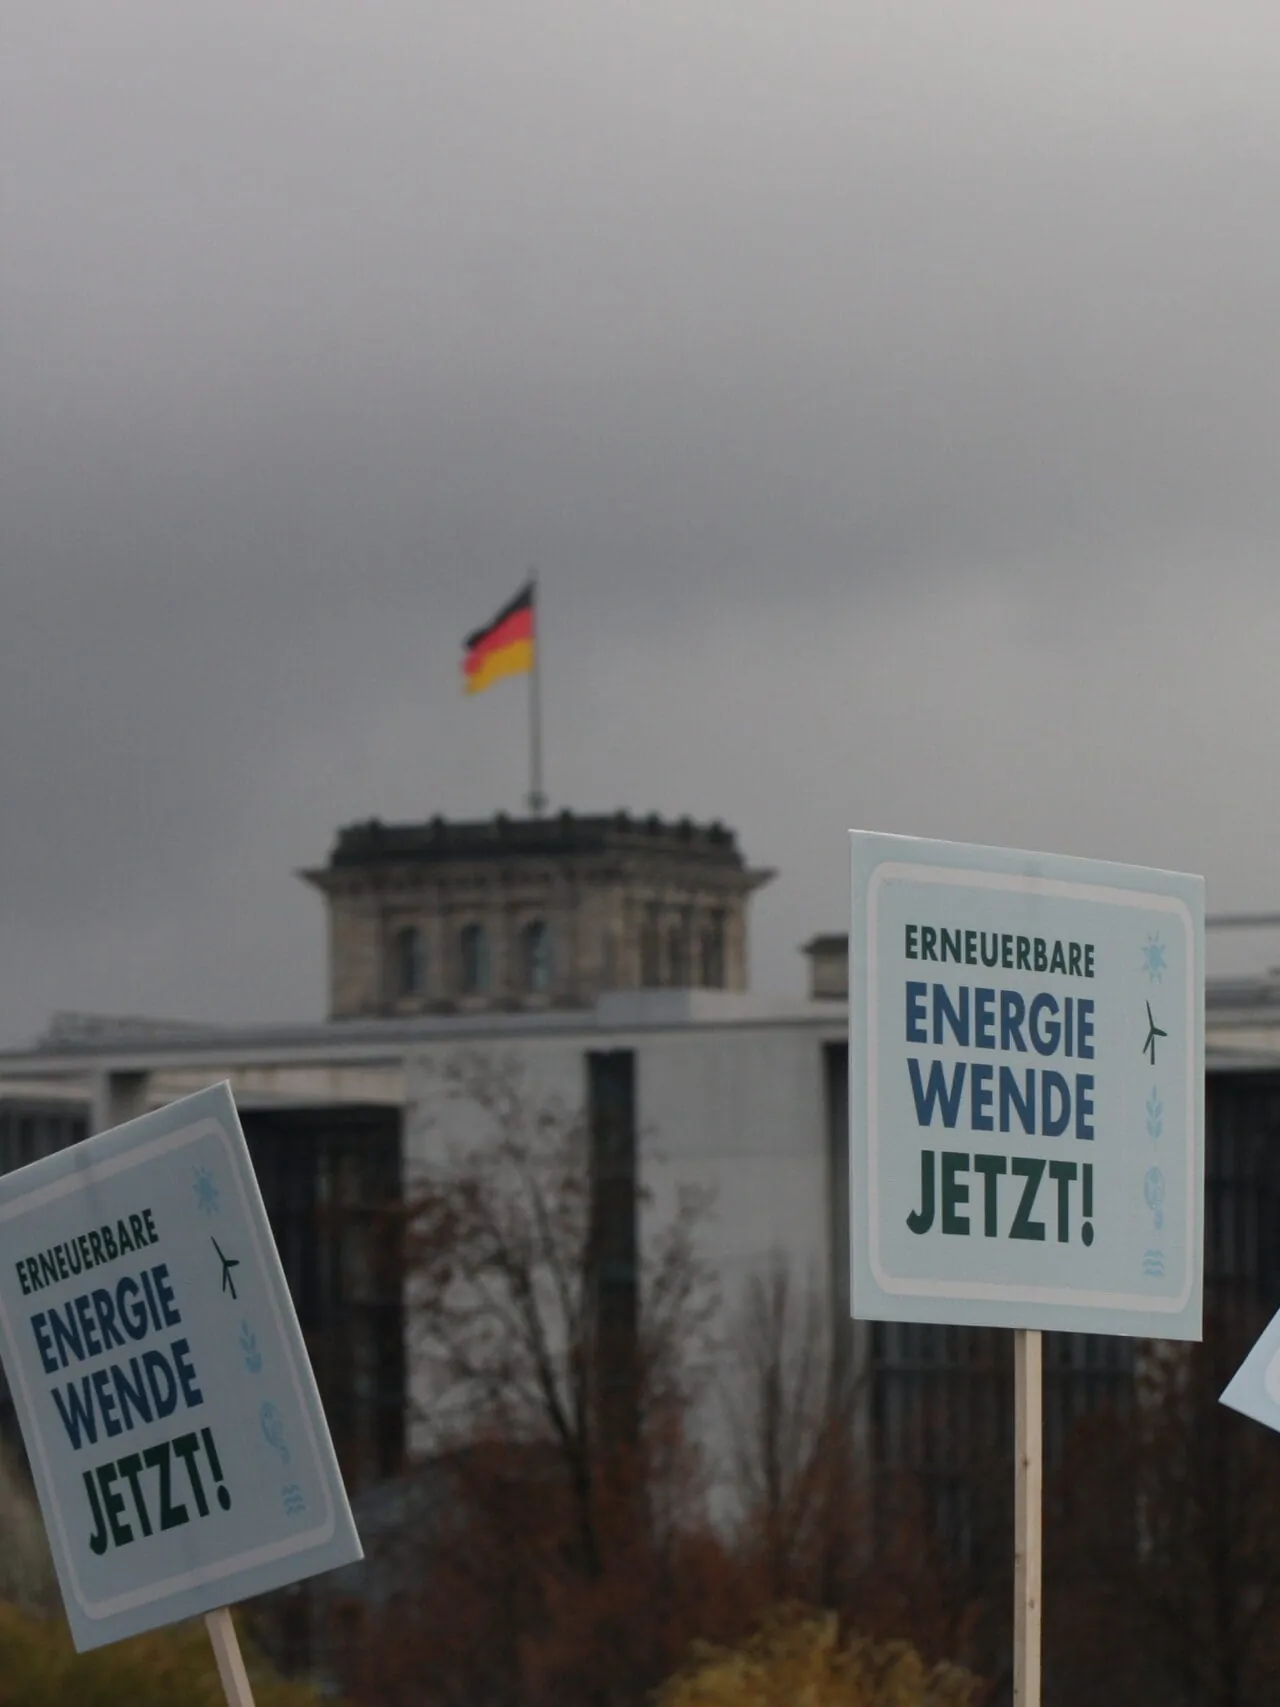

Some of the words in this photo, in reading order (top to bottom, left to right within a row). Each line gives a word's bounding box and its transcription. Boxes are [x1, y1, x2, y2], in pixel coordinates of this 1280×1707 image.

[905, 924, 1095, 978] ERNEUERBARE
[905, 980, 1095, 1059] ENERGIE
[906, 1058, 1095, 1141] WENDE
[906, 1149, 1094, 1247] JETZT!
[16, 1208, 160, 1295] ERNEUERBARE
[30, 1263, 182, 1374] ENERGIE
[51, 1338, 204, 1450] WENDE
[82, 1427, 232, 1556] JETZT!
